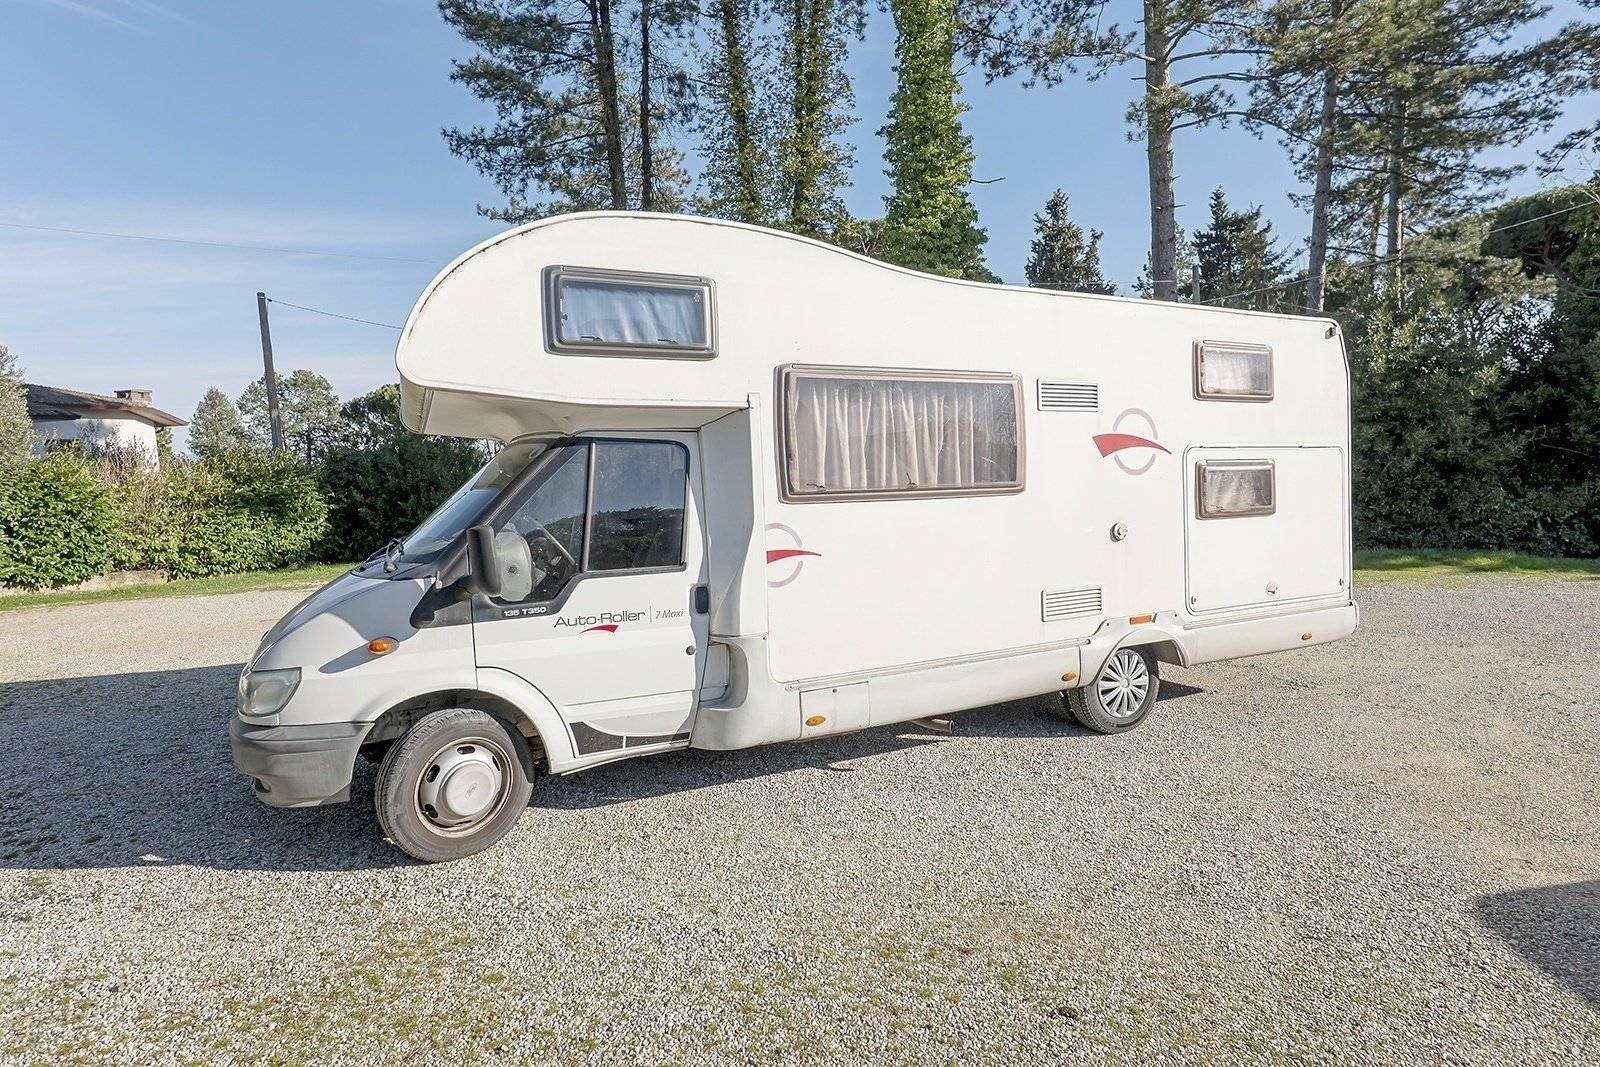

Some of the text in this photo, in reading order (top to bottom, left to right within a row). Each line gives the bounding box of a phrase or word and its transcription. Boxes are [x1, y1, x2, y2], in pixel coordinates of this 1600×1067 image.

[503, 606, 547, 617] 135 T350
[655, 610, 661, 619] 7
[662, 608, 685, 619] Maxi
